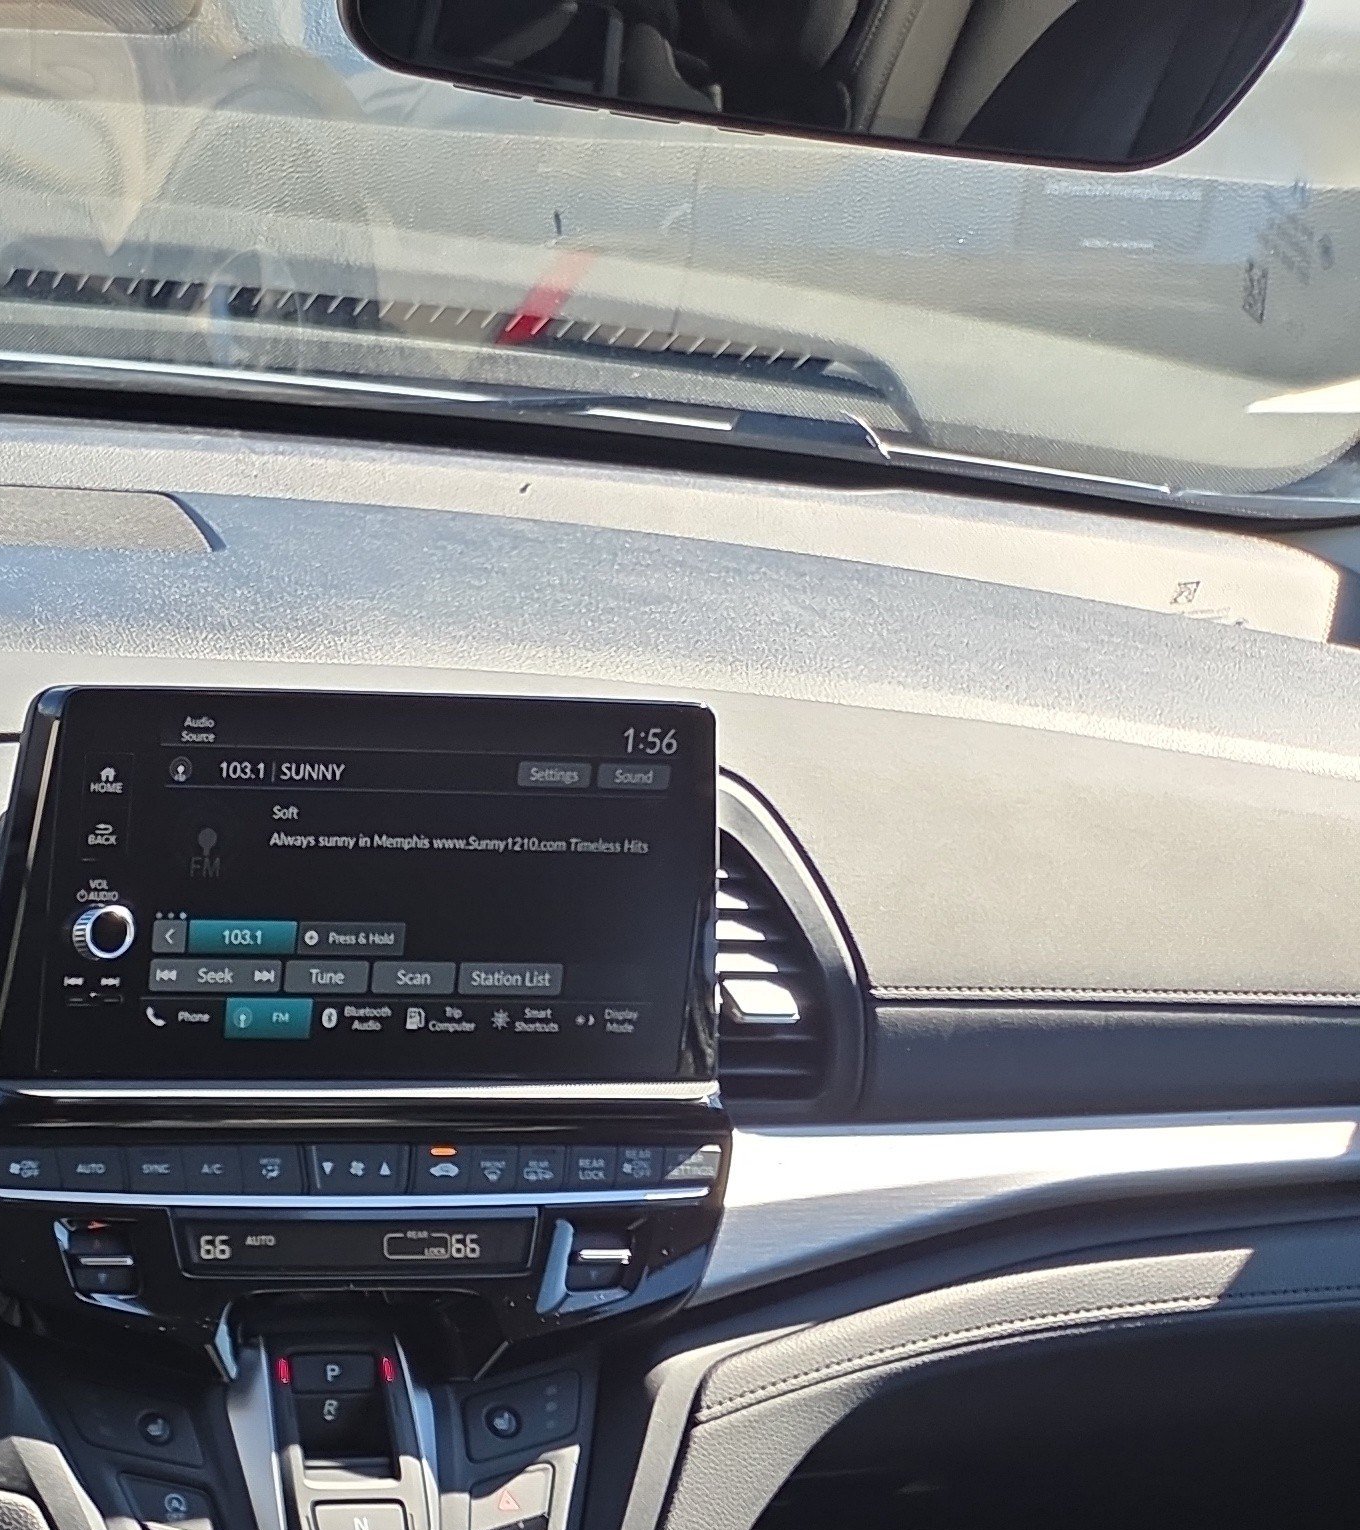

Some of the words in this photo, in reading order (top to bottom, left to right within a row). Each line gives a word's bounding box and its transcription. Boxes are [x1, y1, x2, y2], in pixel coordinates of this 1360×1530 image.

[184, 716, 215, 728] Audio
[181, 731, 216, 742] Source
[624, 727, 678, 754] 1:56
[220, 761, 265, 779] 103.1
[280, 763, 346, 781] SUNNY
[530, 767, 579, 784] Settings
[614, 769, 653, 784] Sound
[90, 782, 123, 793] HOME
[272, 805, 299, 819] Soft
[88, 835, 117, 845] BACK
[270, 832, 315, 849] Always
[318, 835, 356, 849] sunny
[359, 833, 371, 847] in
[373, 834, 430, 850] Memphis
[433, 836, 567, 852] www.Sunny1210.com
[569, 838, 621, 852] Timeless
[623, 839, 649, 853] Hits
[90, 880, 109, 889] VOL
[223, 929, 262, 945] 103.1
[329, 931, 356, 944] Press
[358, 932, 367, 944] &
[369, 932, 395, 945] Hold
[197, 968, 233, 984] Seek
[309, 968, 345, 985] Tune
[396, 970, 430, 985] Scan
[471, 971, 522, 986] Station
[525, 971, 551, 987] List
[177, 1011, 210, 1022] Phone
[272, 1011, 290, 1023] FM
[344, 1006, 392, 1018] Bluetooth
[524, 1008, 552, 1019] Smart
[352, 1020, 381, 1031] Audio
[429, 1021, 476, 1033] Computer
[76, 1164, 106, 1174] AUTO
[200, 1236, 230, 1260] 66
[245, 1236, 275, 1246] AUTO
[451, 1234, 480, 1258] 66
[326, 1364, 340, 1382] P
